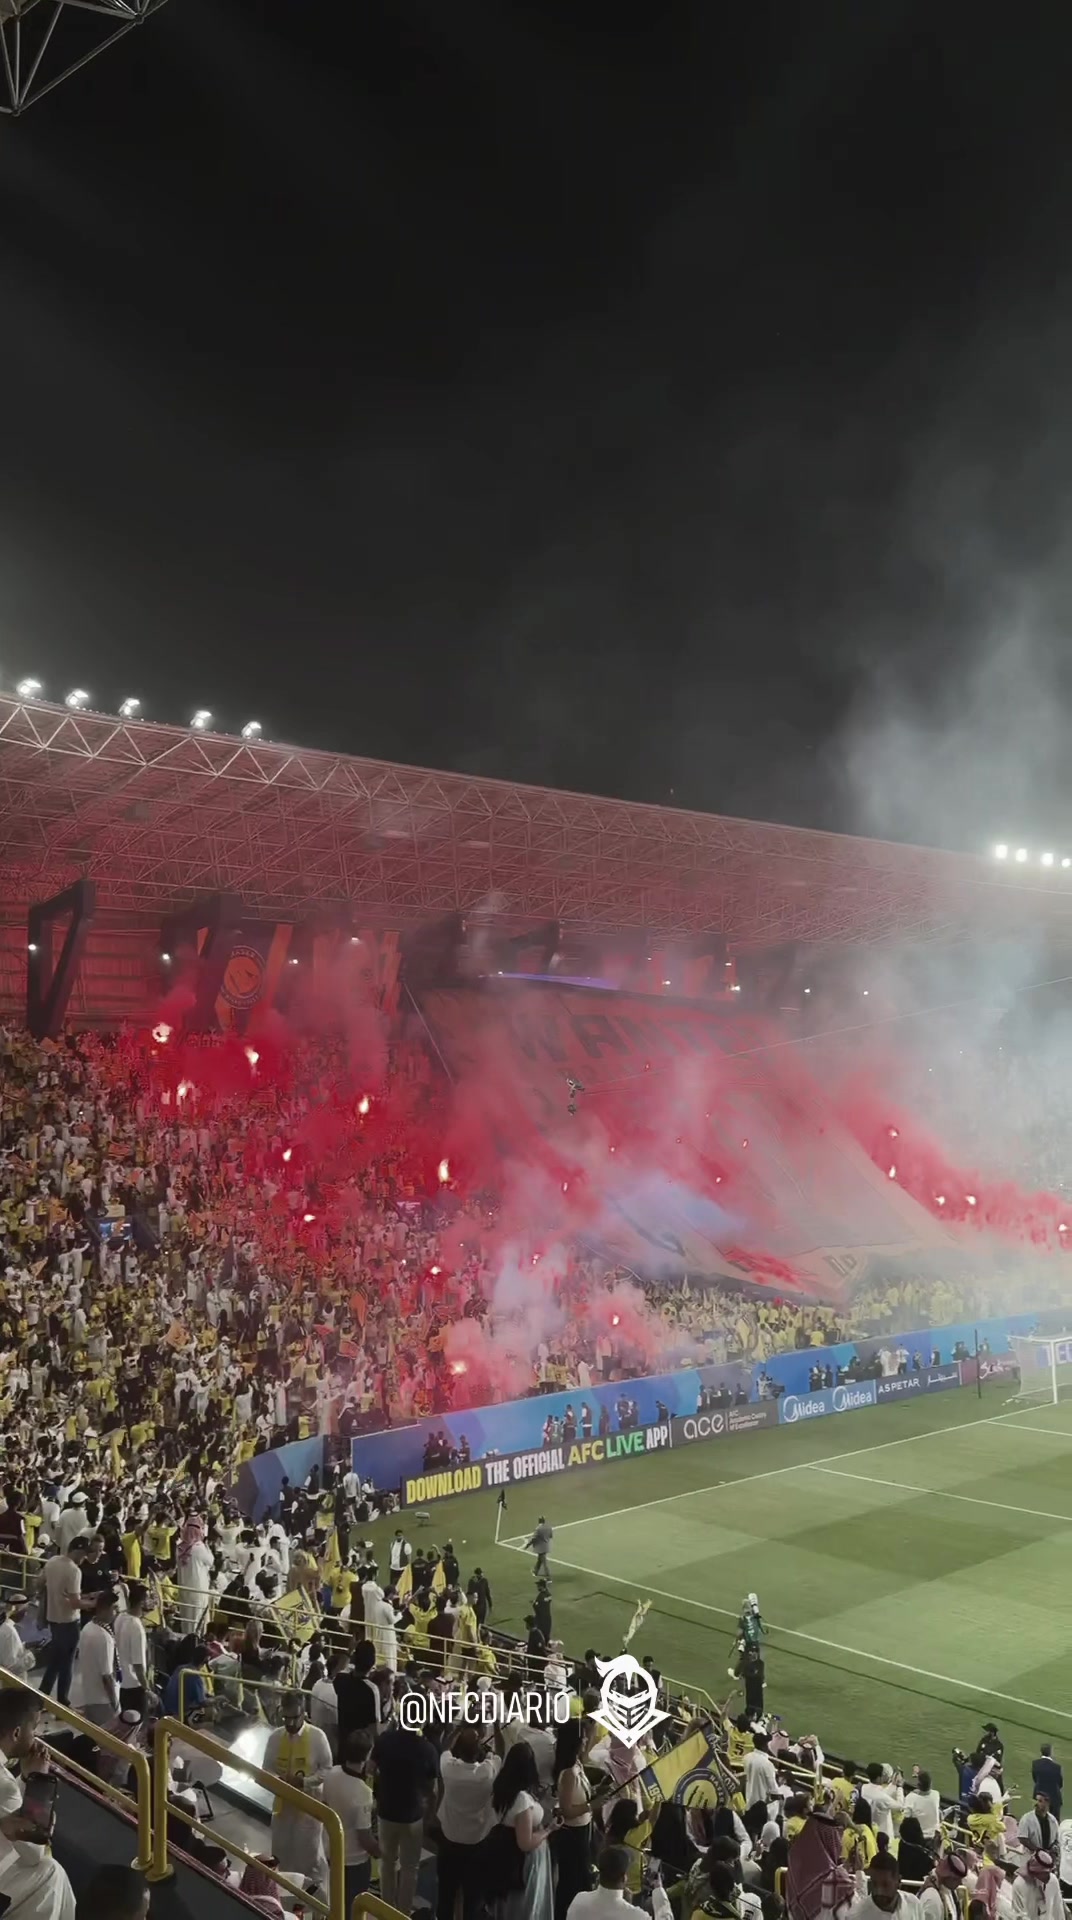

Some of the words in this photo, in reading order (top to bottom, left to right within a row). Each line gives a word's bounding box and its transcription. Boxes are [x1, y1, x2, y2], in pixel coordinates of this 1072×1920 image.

[878, 1378, 921, 1394] ASPETAR
[787, 1398, 825, 1419] Midea
[837, 1389, 872, 1409] Midea
[683, 1413, 725, 1440] ace
[406, 1465, 482, 1505] DOWNLOAD
[485, 1461, 510, 1486] THE
[513, 1448, 565, 1479] OFFICIAL
[646, 1425, 668, 1450] APP
